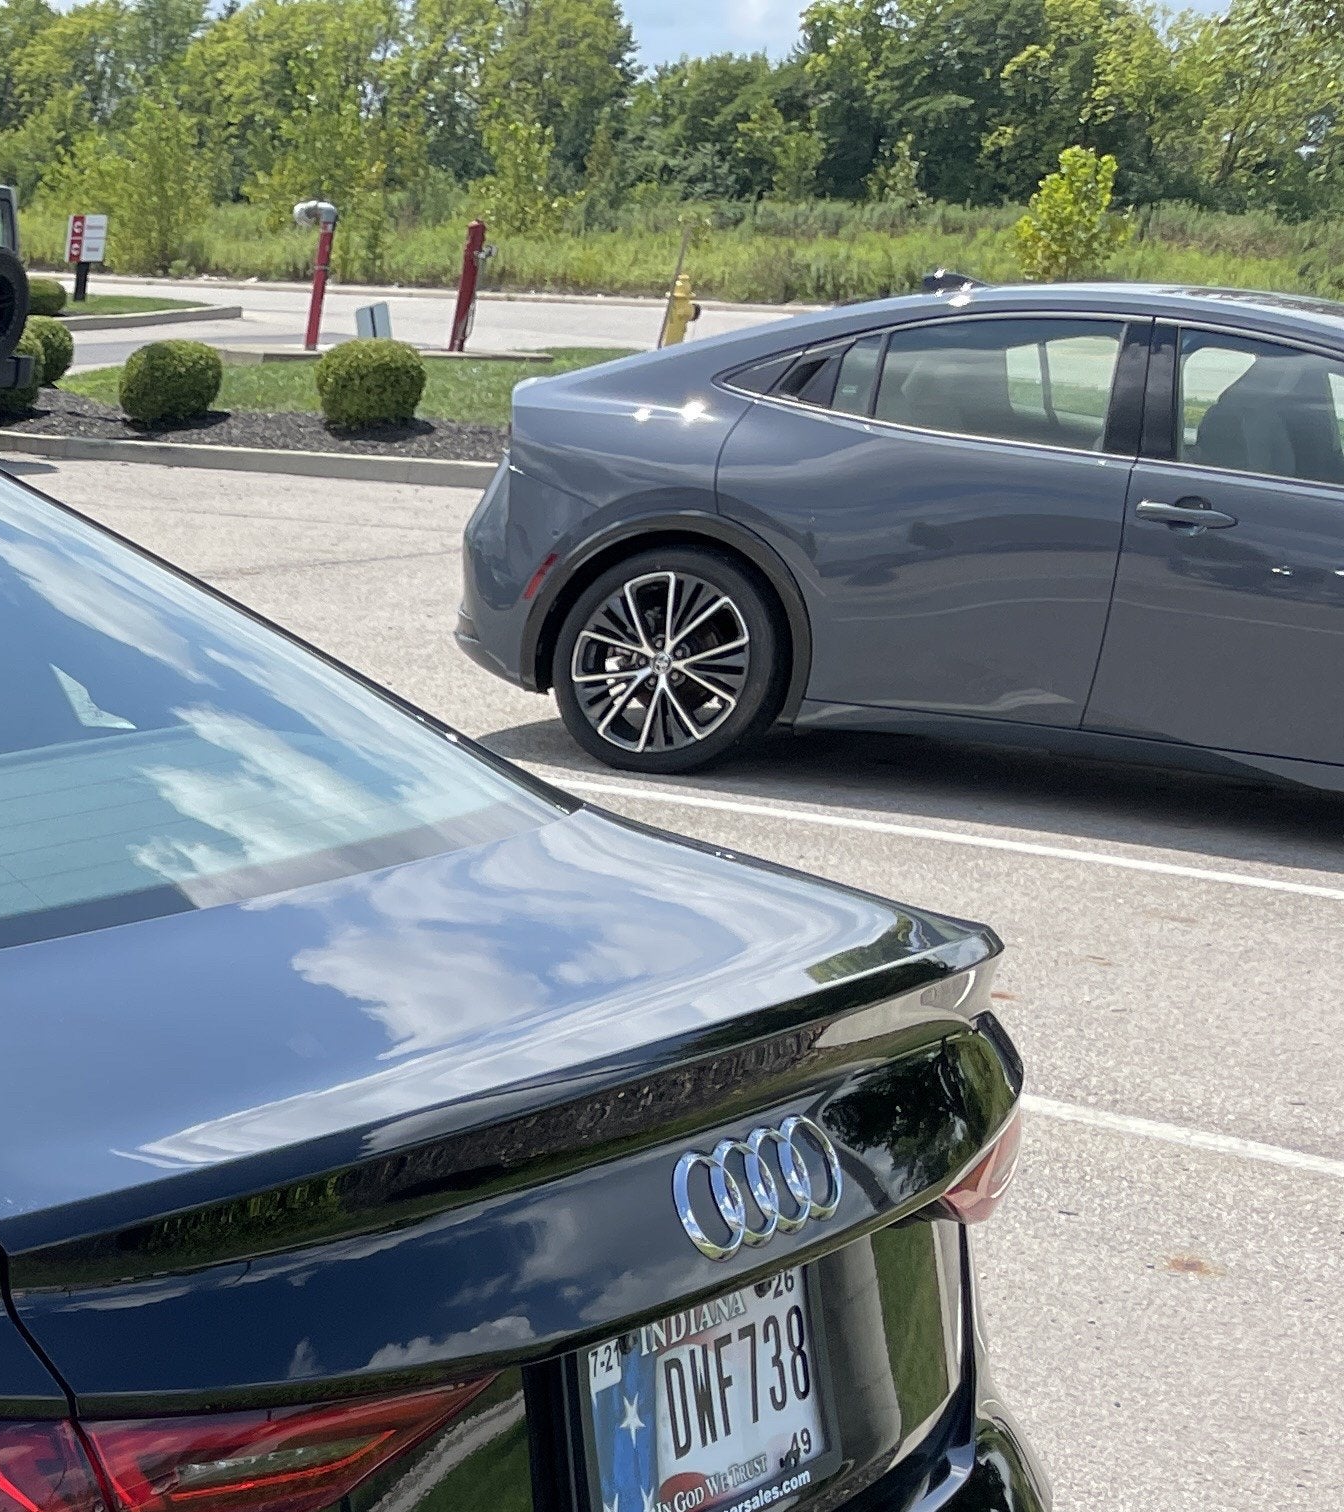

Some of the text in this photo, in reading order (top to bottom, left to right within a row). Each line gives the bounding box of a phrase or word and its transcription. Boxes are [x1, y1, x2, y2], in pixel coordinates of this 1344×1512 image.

[639, 1290, 748, 1358] INDIANA
[662, 1304, 811, 1461] DWF738
[705, 1472, 729, 1498] WE
[728, 1454, 768, 1488] TRUST
